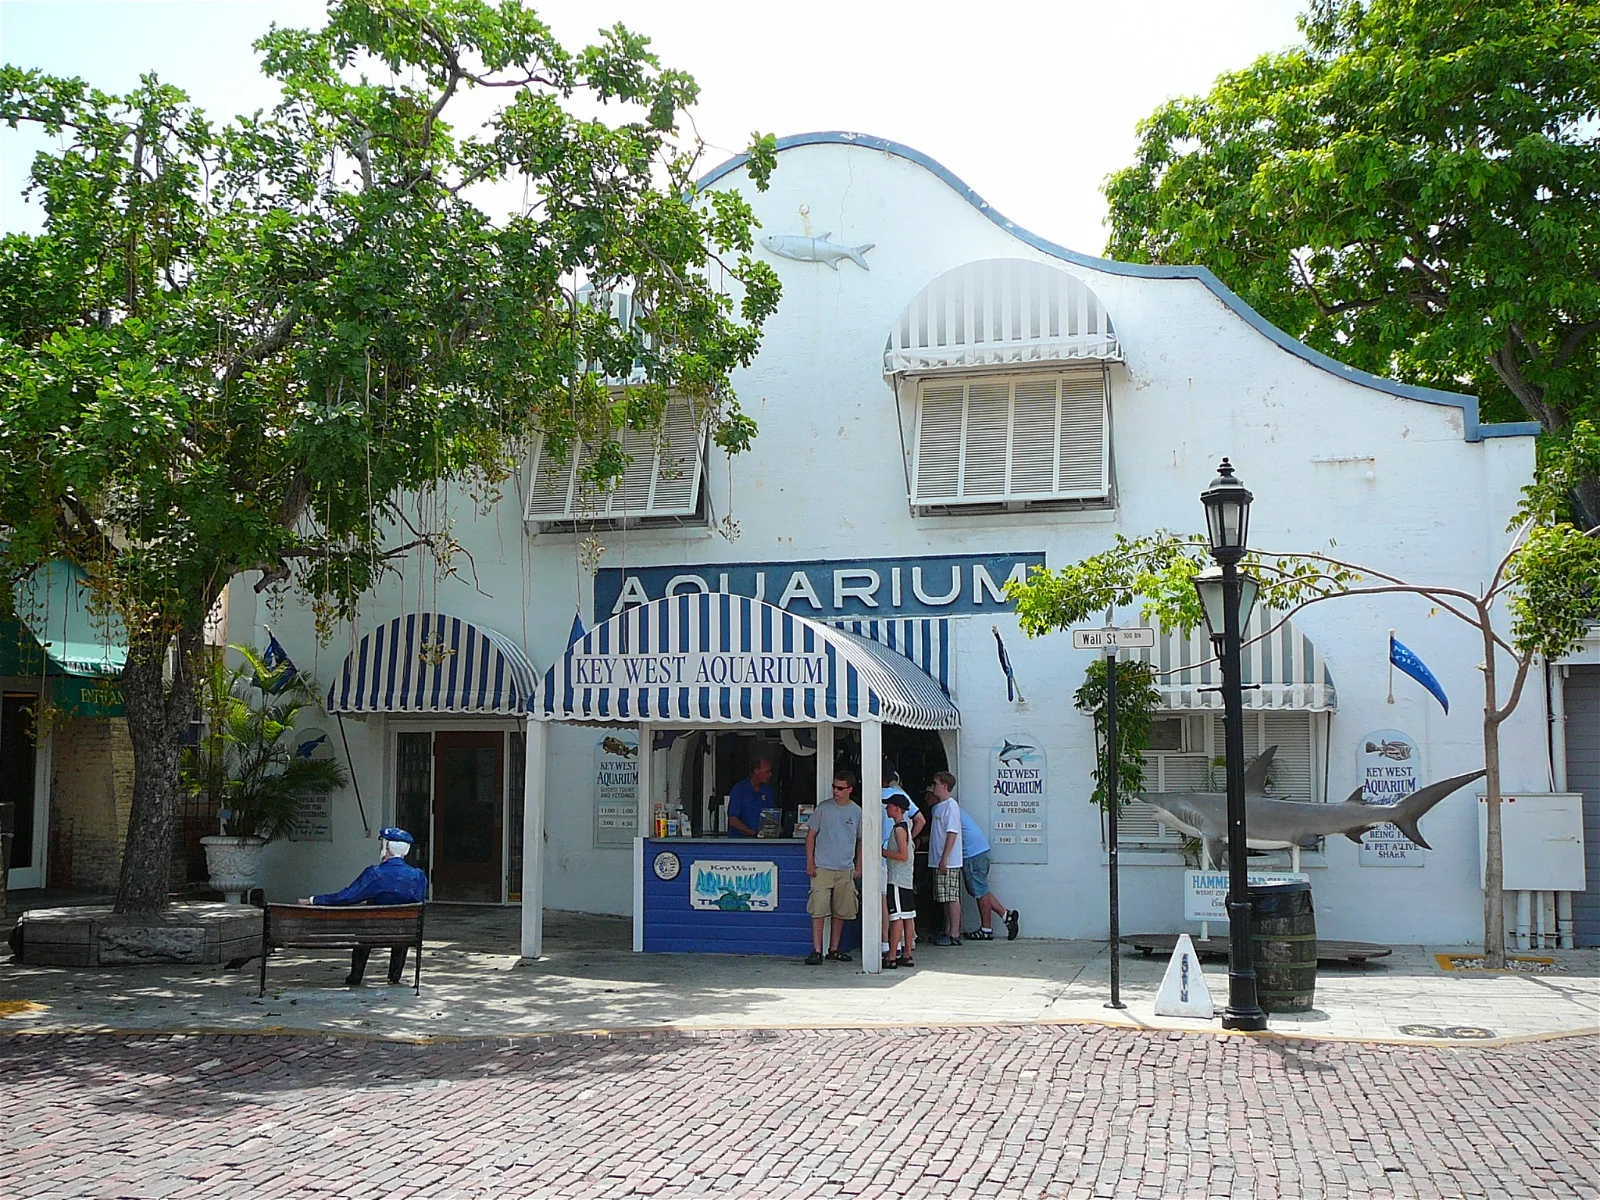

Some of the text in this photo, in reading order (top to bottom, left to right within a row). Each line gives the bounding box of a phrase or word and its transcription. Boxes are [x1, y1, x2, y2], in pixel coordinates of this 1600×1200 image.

[1083, 633, 1102, 645] Wall
[1106, 633, 1117, 645] St
[575, 655, 824, 686] KEY WEST AQUARIUM
[600, 761, 638, 771] KEY WEST
[1366, 766, 1412, 777] KEY WEST
[597, 771, 639, 787] AQUARIUM
[998, 769, 1040, 779] KEY WEST
[993, 779, 1043, 797] AQUARIUM
[1363, 777, 1416, 796] AQUARIUM
[1369, 830, 1394, 839] BEING
[1364, 843, 1371, 851] &
[1374, 843, 1390, 851] PET
[710, 864, 730, 872] Key
[694, 867, 773, 893] AQUARIUM
[697, 898, 770, 907] TITS
